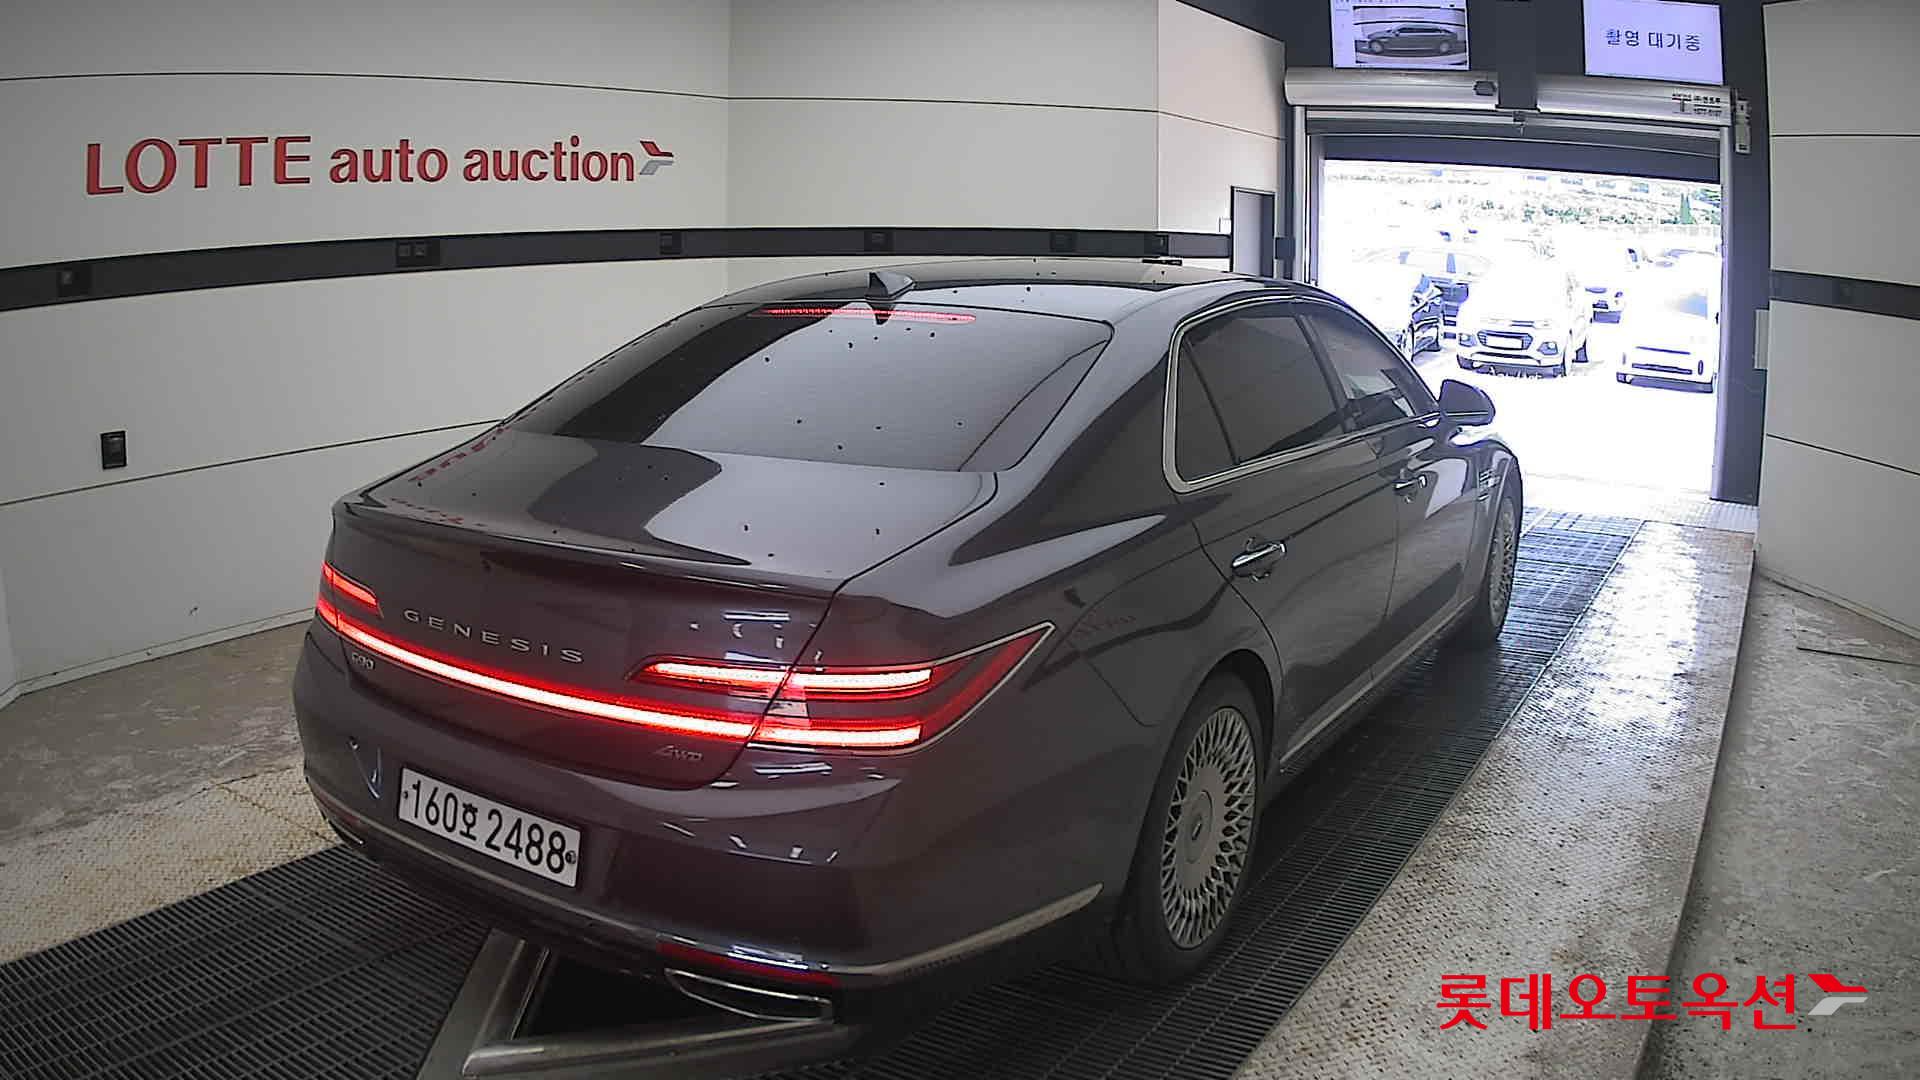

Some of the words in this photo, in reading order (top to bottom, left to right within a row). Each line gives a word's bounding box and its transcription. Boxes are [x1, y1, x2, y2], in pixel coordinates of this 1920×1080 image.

[1648, 32, 1700, 52] 대기중
[86, 136, 311, 196] LOTTE
[329, 138, 448, 184] auto
[463, 135, 635, 182] auction
[403, 609, 583, 664] GENESIS
